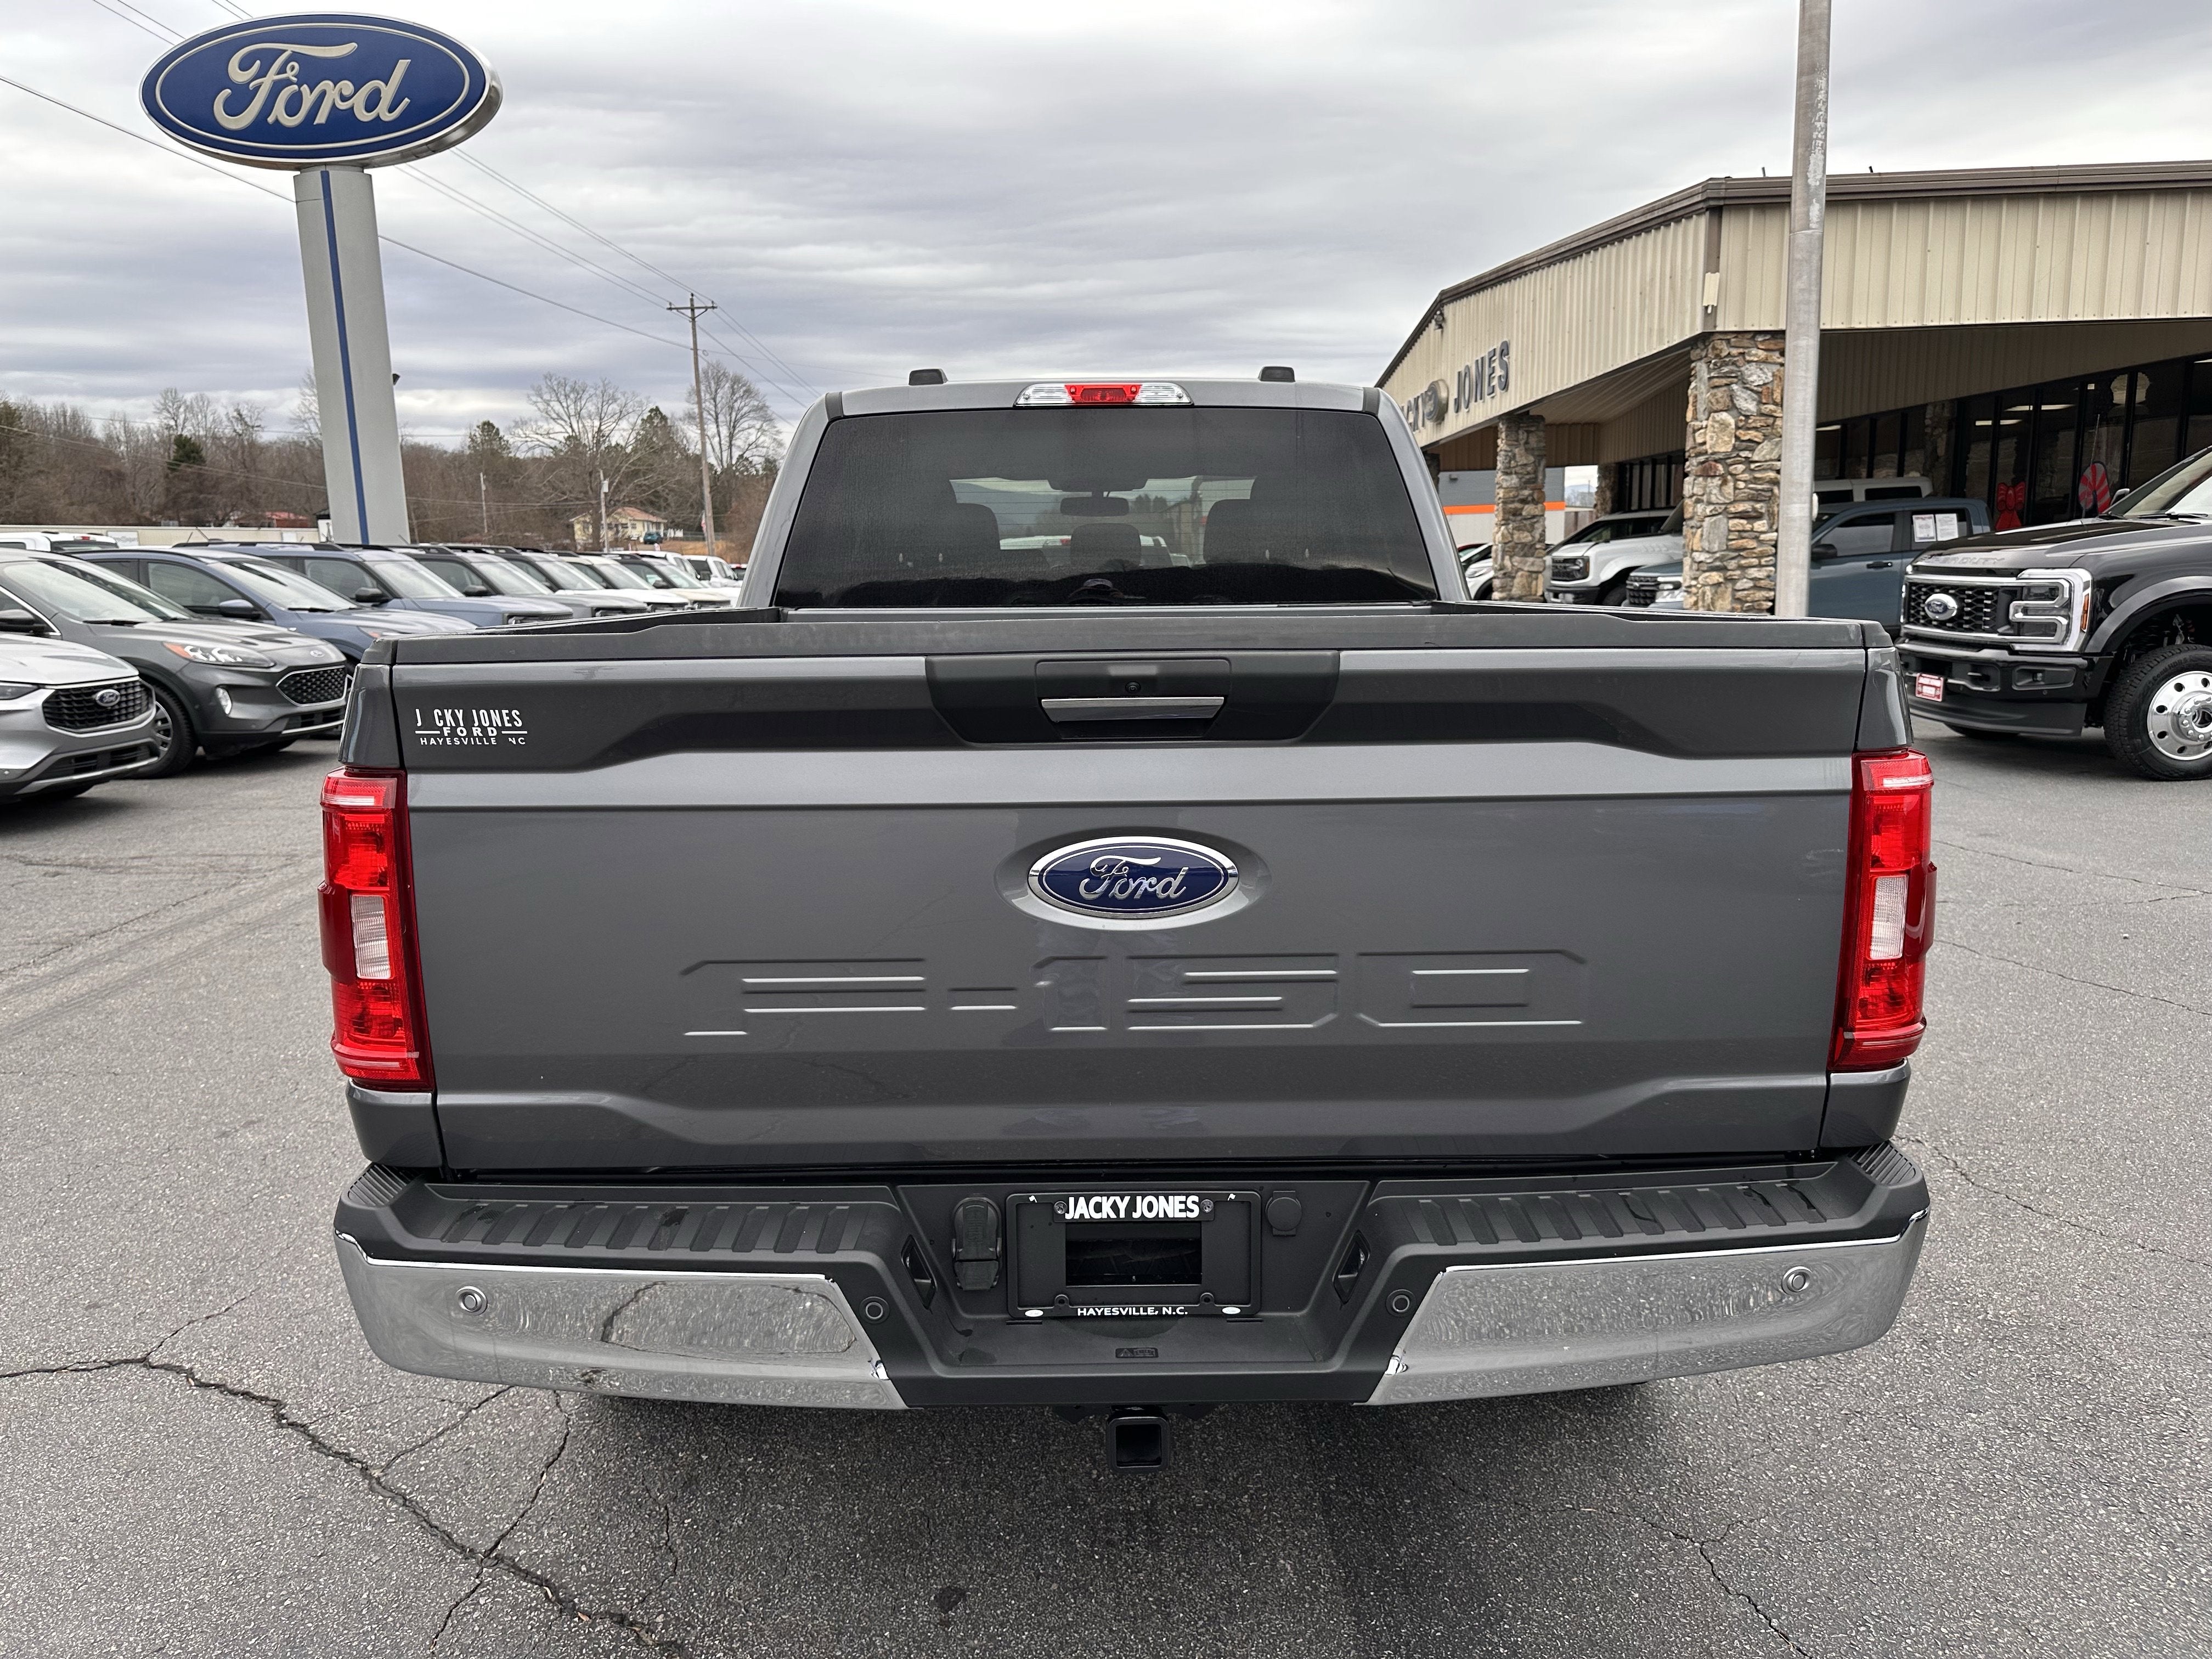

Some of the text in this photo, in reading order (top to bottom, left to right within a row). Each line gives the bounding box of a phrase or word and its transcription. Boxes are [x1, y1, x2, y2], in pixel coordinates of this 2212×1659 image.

[213, 42, 411, 131] Ford
[1401, 391, 1428, 432] CKY
[1454, 340, 1510, 414] JONES
[415, 708, 522, 727] JCKY JONES
[442, 727, 498, 737] FORD
[1079, 855, 1189, 900] Ford
[680, 949, 1589, 1036] F-150
[1065, 1195, 1199, 1220] JACKY JONES
[1077, 1306, 1188, 1316] HAYESVILLE, N.C.
